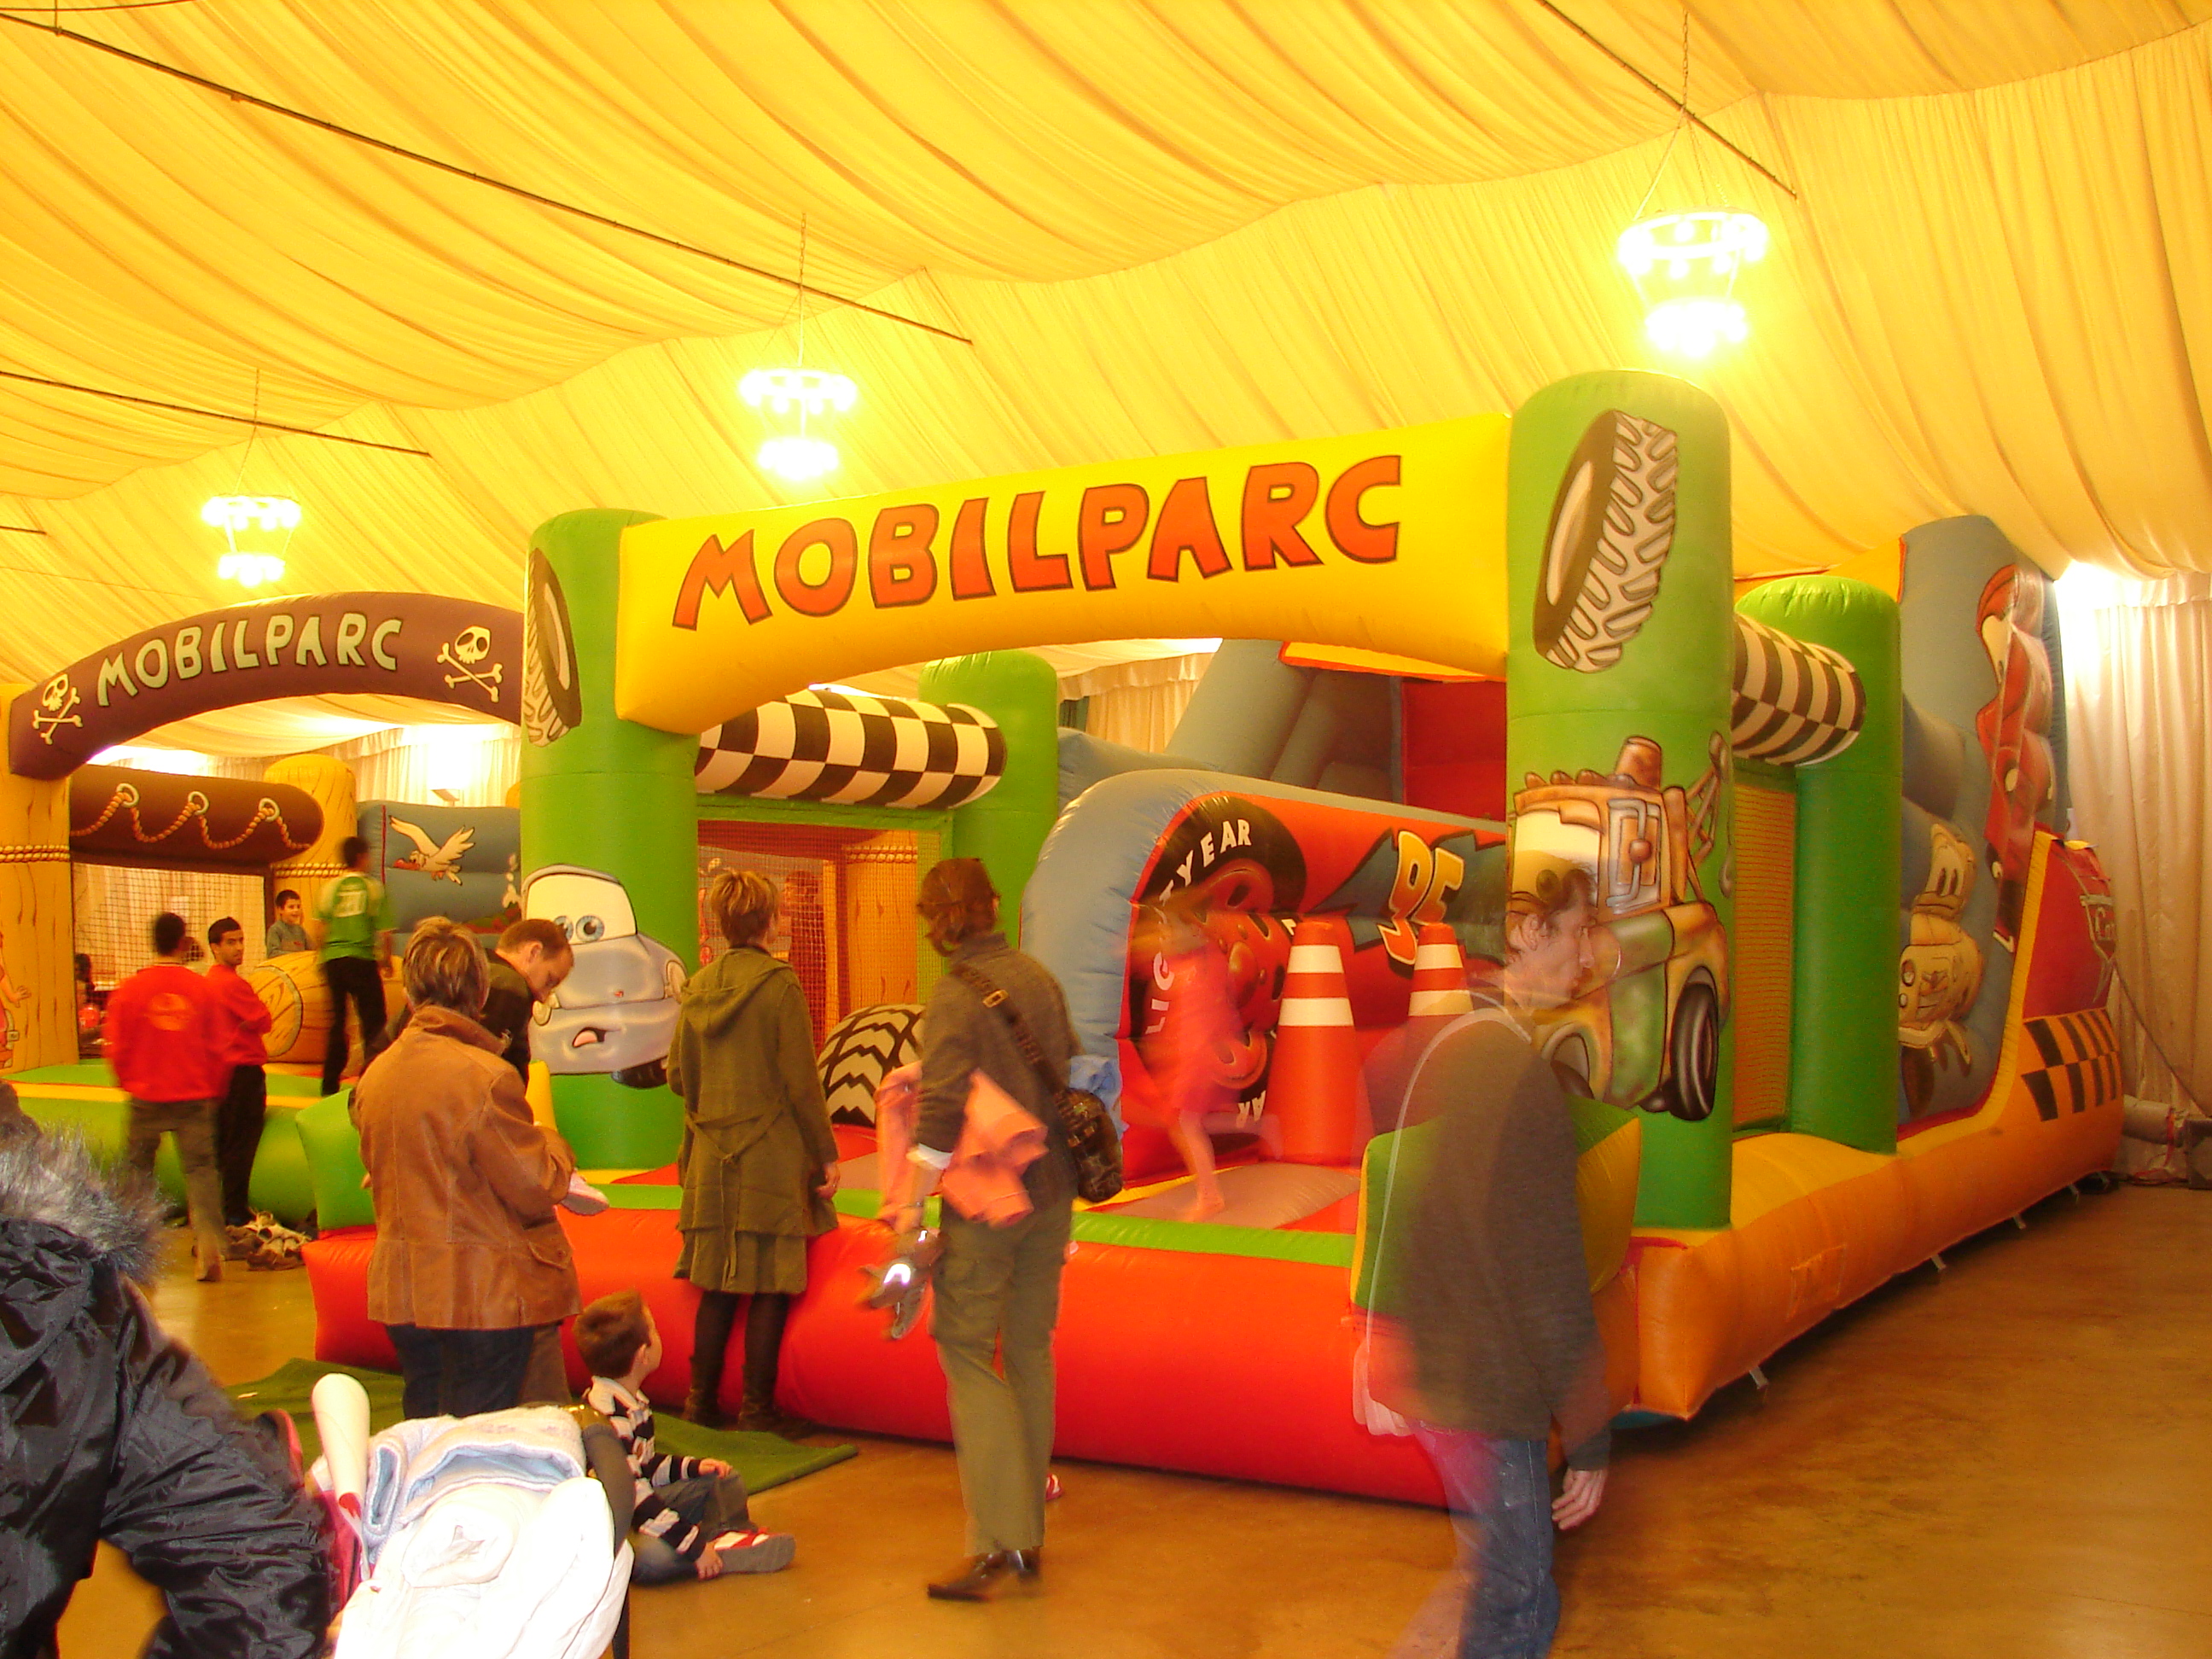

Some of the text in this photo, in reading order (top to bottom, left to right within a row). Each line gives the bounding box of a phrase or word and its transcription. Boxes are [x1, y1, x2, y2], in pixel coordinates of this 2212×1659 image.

[672, 454, 1402, 632] MOBILPARC
[97, 613, 402, 707] MOBILPARC
[1144, 818, 1252, 1034] LIGTYEAR
